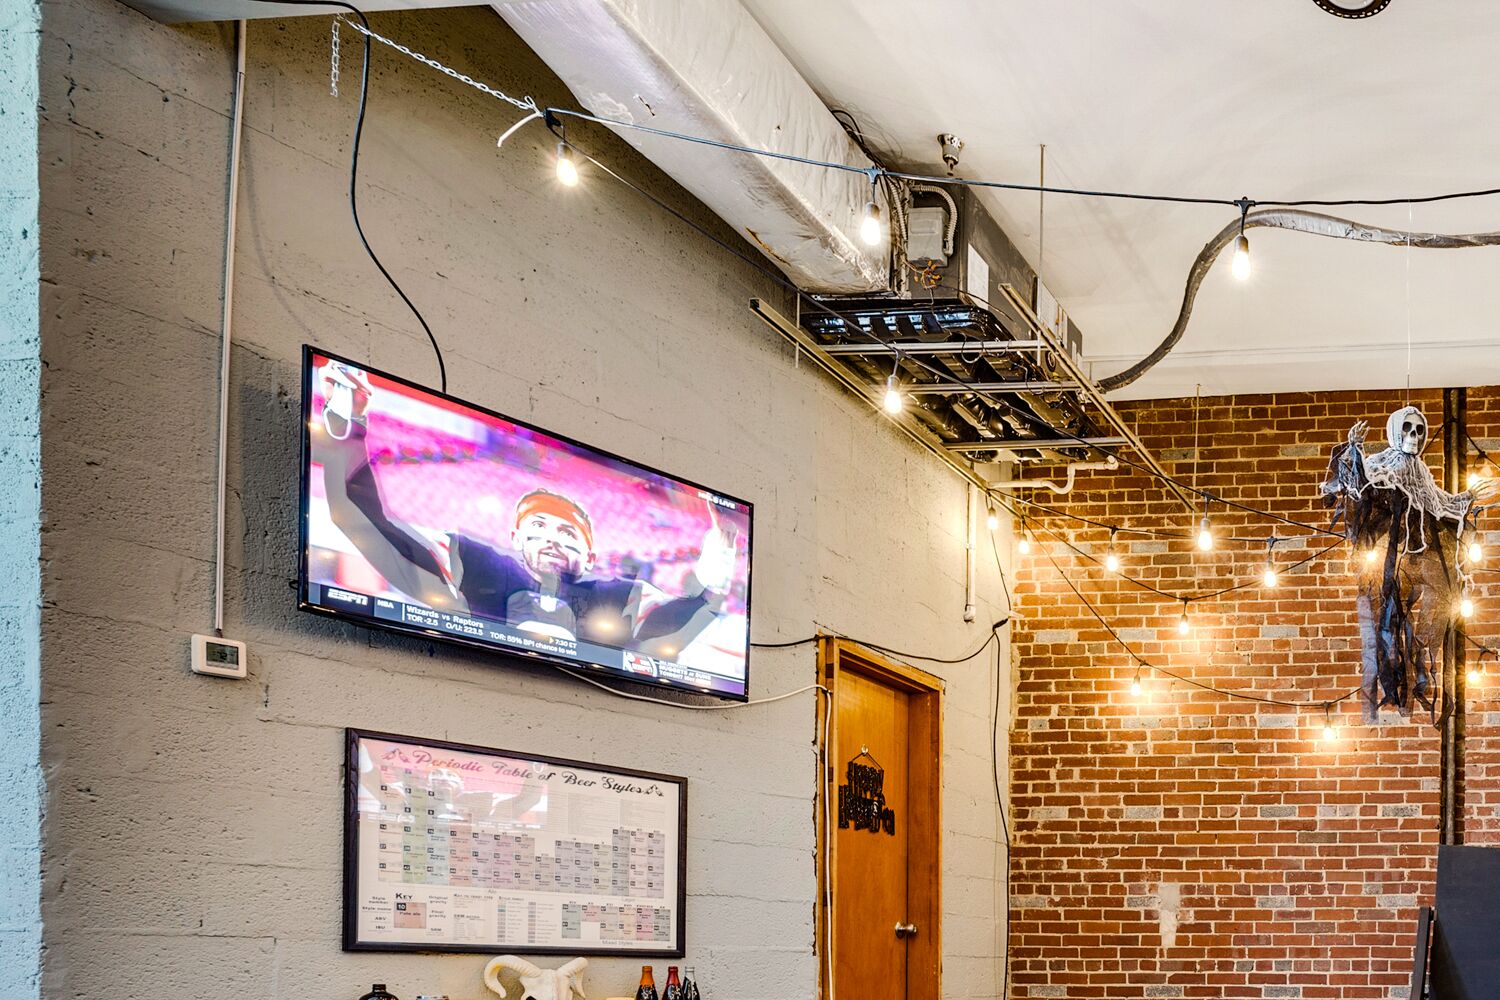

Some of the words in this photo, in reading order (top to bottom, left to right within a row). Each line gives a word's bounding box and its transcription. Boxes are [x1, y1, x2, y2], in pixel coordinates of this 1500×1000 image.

[327, 588, 368, 606] ESPN
[377, 599, 394, 609] NBA
[406, 605, 439, 619] Wizards
[453, 615, 484, 629] Raptors
[406, 613, 424, 623] TOR
[463, 625, 484, 637] 223.5
[489, 631, 507, 642] TOR:
[412, 750, 485, 773] Periodic
[491, 760, 533, 779] Table
[538, 771, 557, 781] of
[561, 770, 597, 787] Beer
[601, 776, 643, 794] Styles
